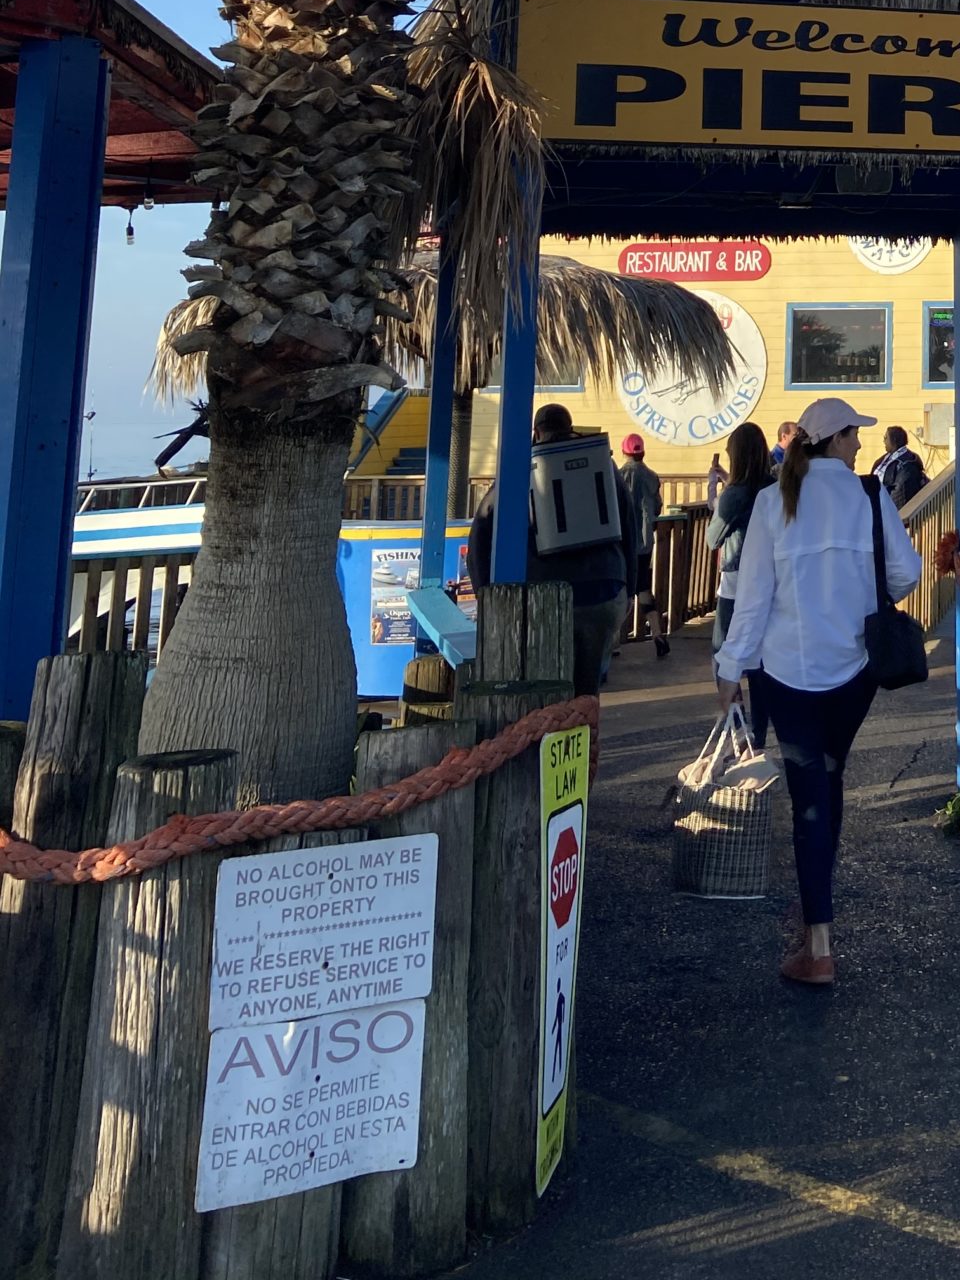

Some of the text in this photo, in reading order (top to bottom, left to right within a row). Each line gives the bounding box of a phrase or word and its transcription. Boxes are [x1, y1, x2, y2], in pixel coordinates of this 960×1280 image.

[626, 250, 762, 273] RESTAURANT & BAR
[622, 372, 759, 440] OSPREY CRUISES
[377, 551, 421, 563] FISHIN
[551, 732, 582, 768] STATE
[556, 767, 577, 800] LAW
[236, 848, 422, 885] NO ALCOHOL MAY BE
[552, 854, 577, 902] STOP
[235, 869, 420, 908] BROUGHT ONTO THIS
[281, 896, 376, 923] PROPERTY
[217, 931, 430, 978] WE RESERVE THE RIGHT
[555, 938, 568, 966] FOR
[219, 953, 426, 1000] TO REFUSE SERVICE TO
[239, 978, 403, 1019] ANYONE, ANYTIME
[216, 1011, 414, 1084] AVISO
[246, 1073, 380, 1116] NO SE PERMITE
[211, 1092, 410, 1146] ENTRAR CON BEBIDAS
[211, 1116, 406, 1170] DE ALCOHOL EN ESTA
